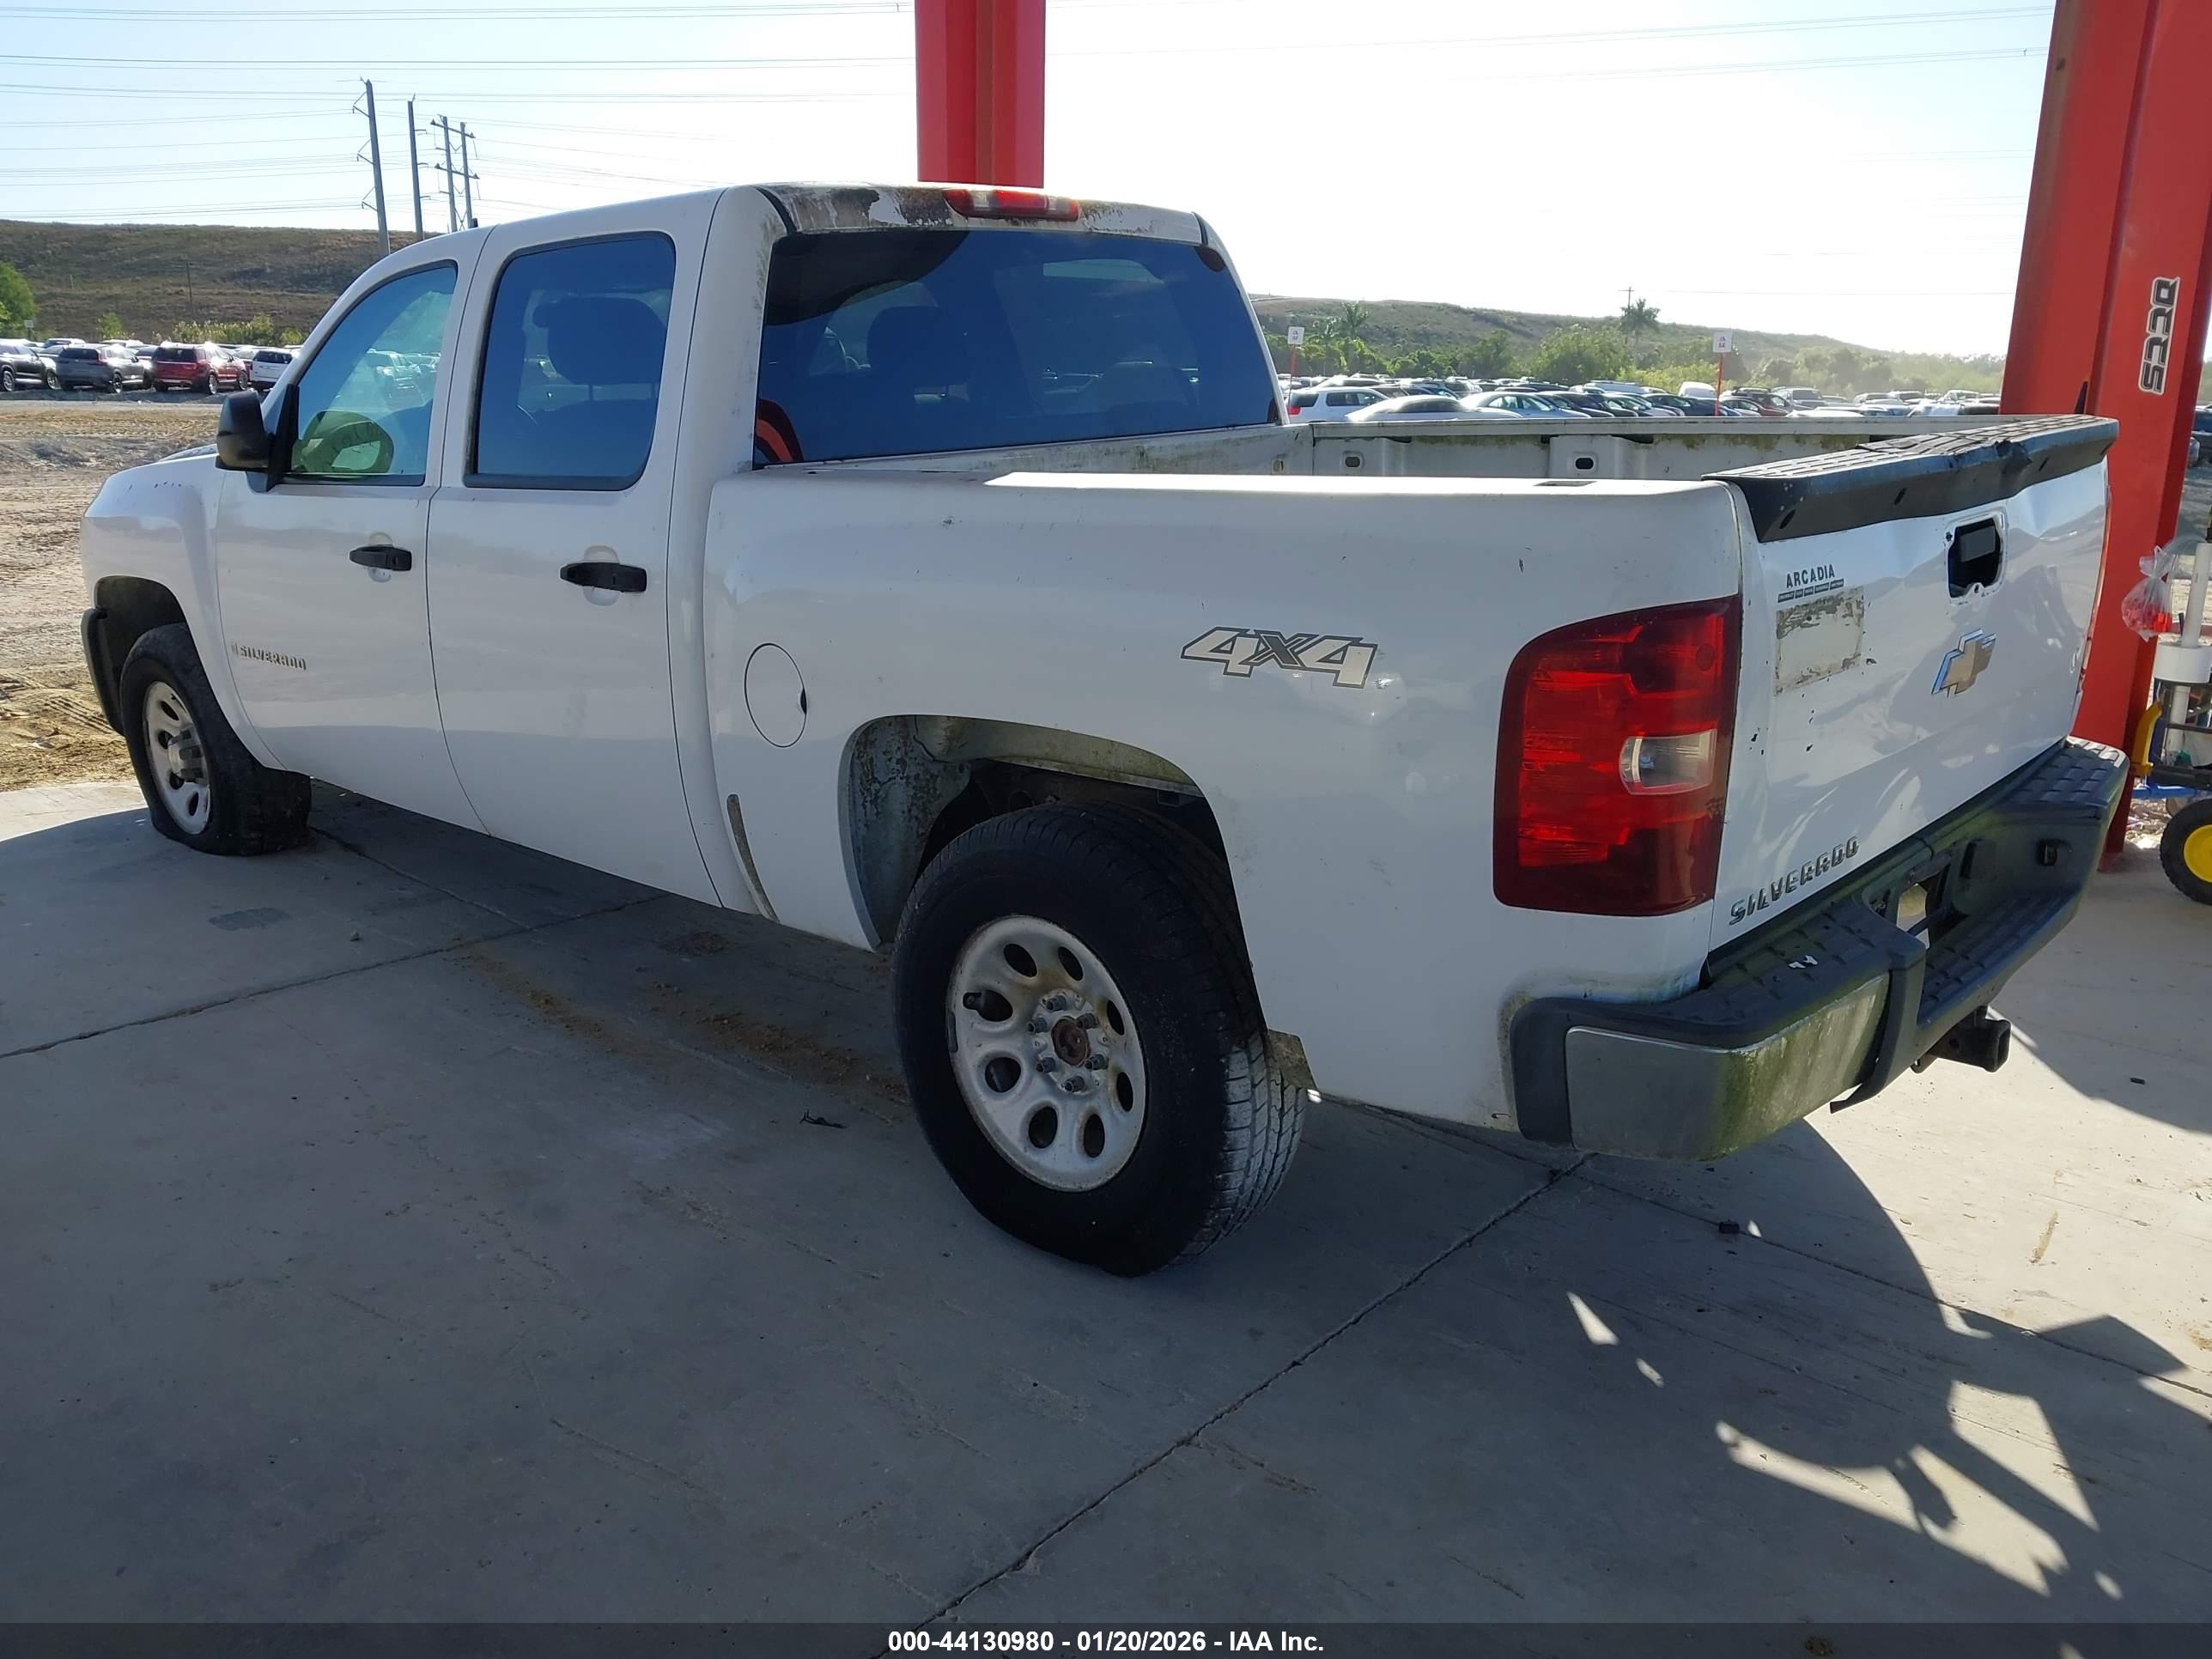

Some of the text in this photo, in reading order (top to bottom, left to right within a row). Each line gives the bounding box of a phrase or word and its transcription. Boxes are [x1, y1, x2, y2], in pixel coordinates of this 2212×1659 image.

[1786, 564, 1836, 589] ARCADIA
[240, 645, 307, 671] SILVERADO
[1729, 836, 1860, 926] SILVERADO
